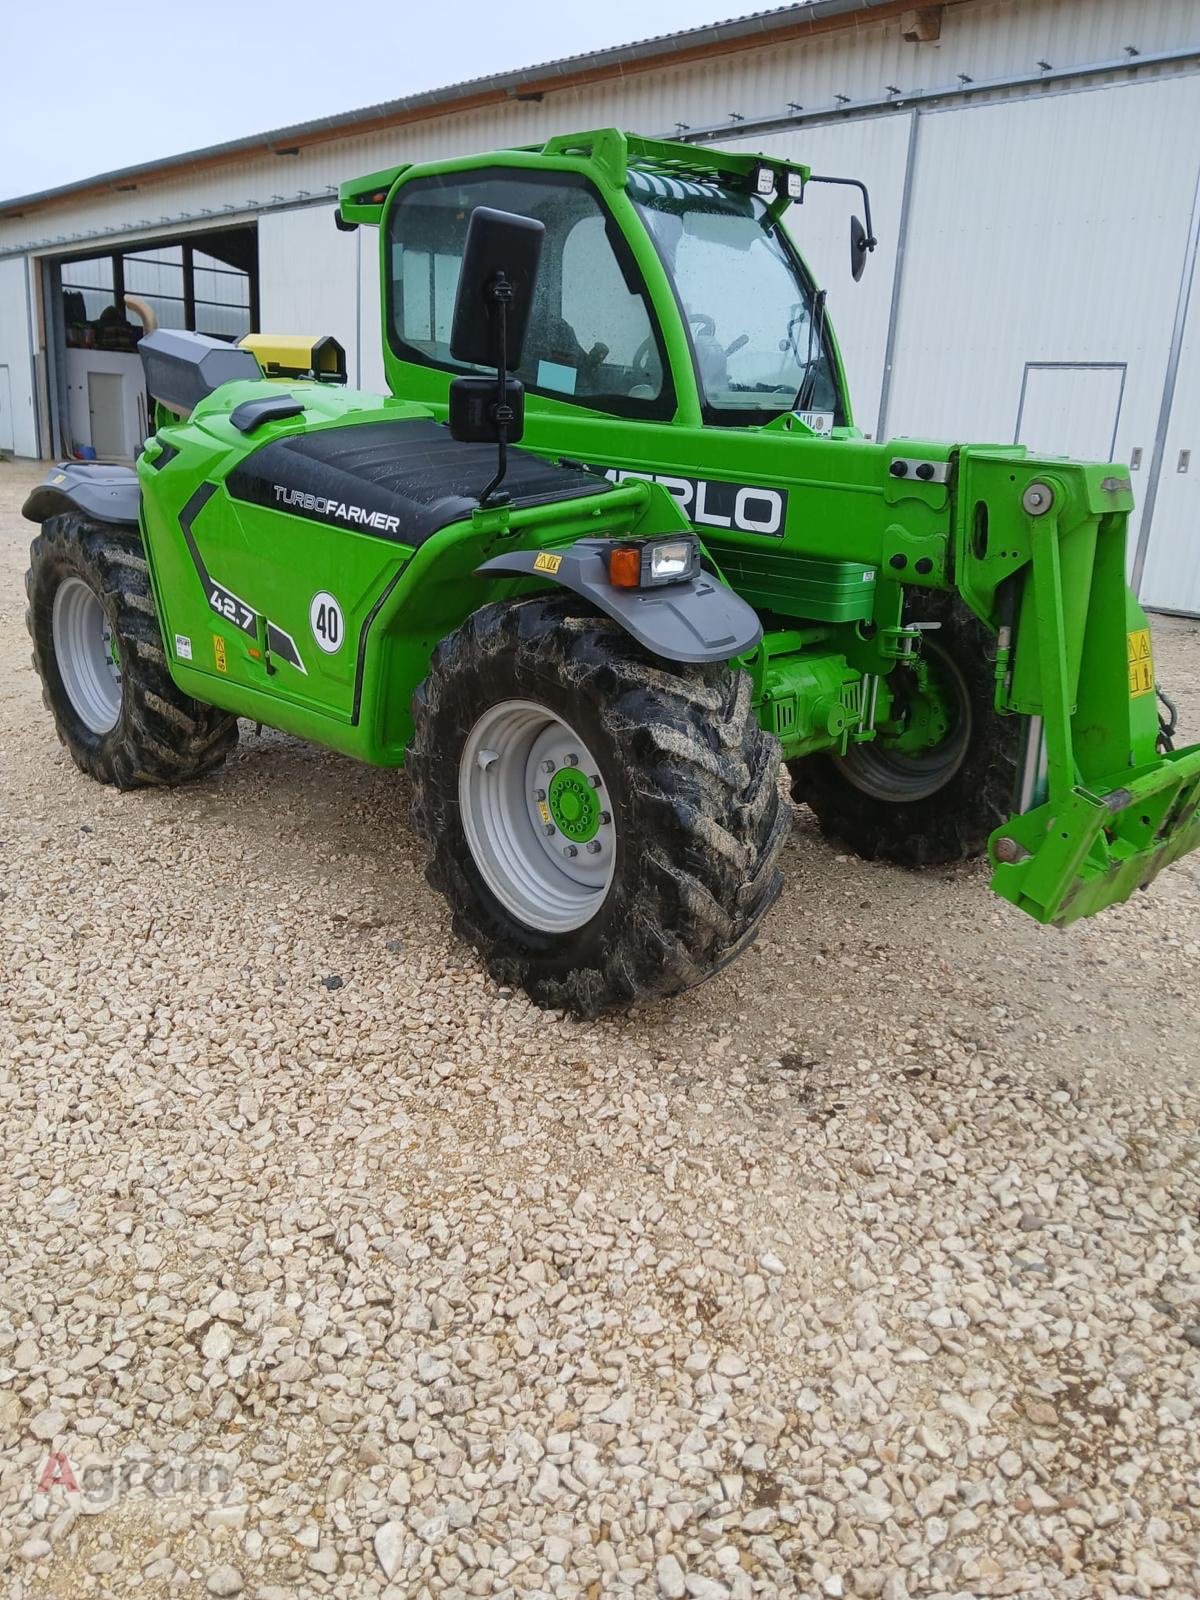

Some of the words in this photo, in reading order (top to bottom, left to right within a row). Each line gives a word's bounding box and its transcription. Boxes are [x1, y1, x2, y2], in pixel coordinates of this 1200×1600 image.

[273, 485, 400, 533] TURBOFARMER
[210, 590, 253, 630] 42.7
[316, 603, 338, 643] 40
